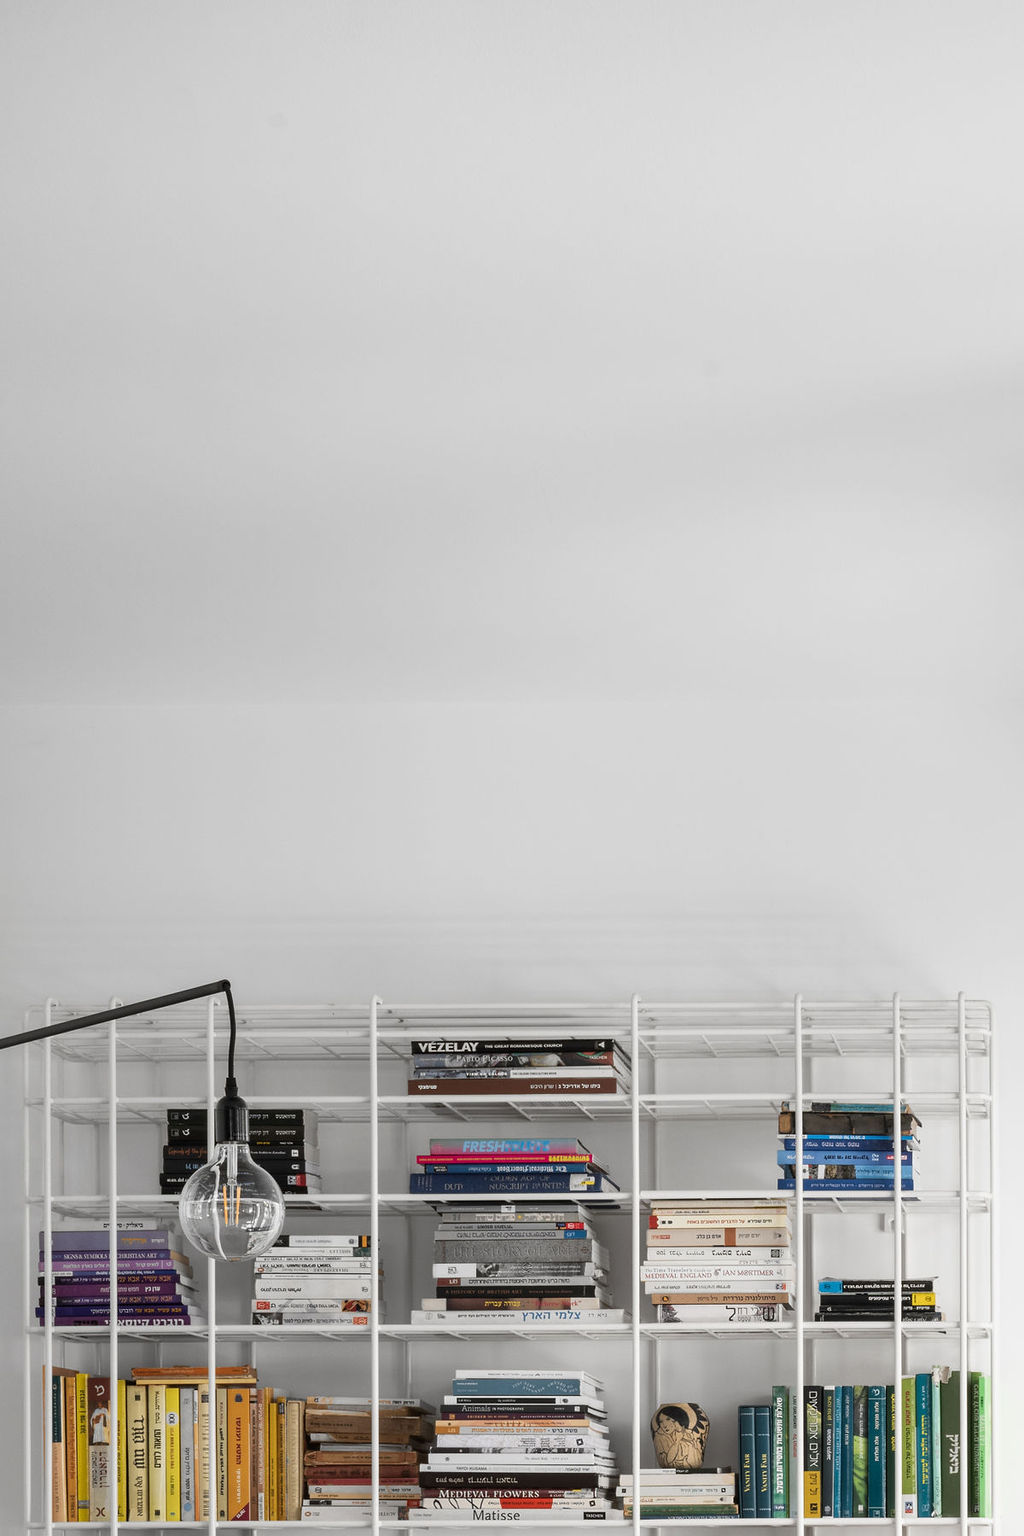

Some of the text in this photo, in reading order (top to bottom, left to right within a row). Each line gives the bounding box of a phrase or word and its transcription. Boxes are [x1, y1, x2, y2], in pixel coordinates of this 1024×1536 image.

[945, 1434, 960, 1475] ביאליק
[438, 1489, 540, 1498] MEDIEVAL FLOWERS
[472, 1509, 520, 1520] Matisse
